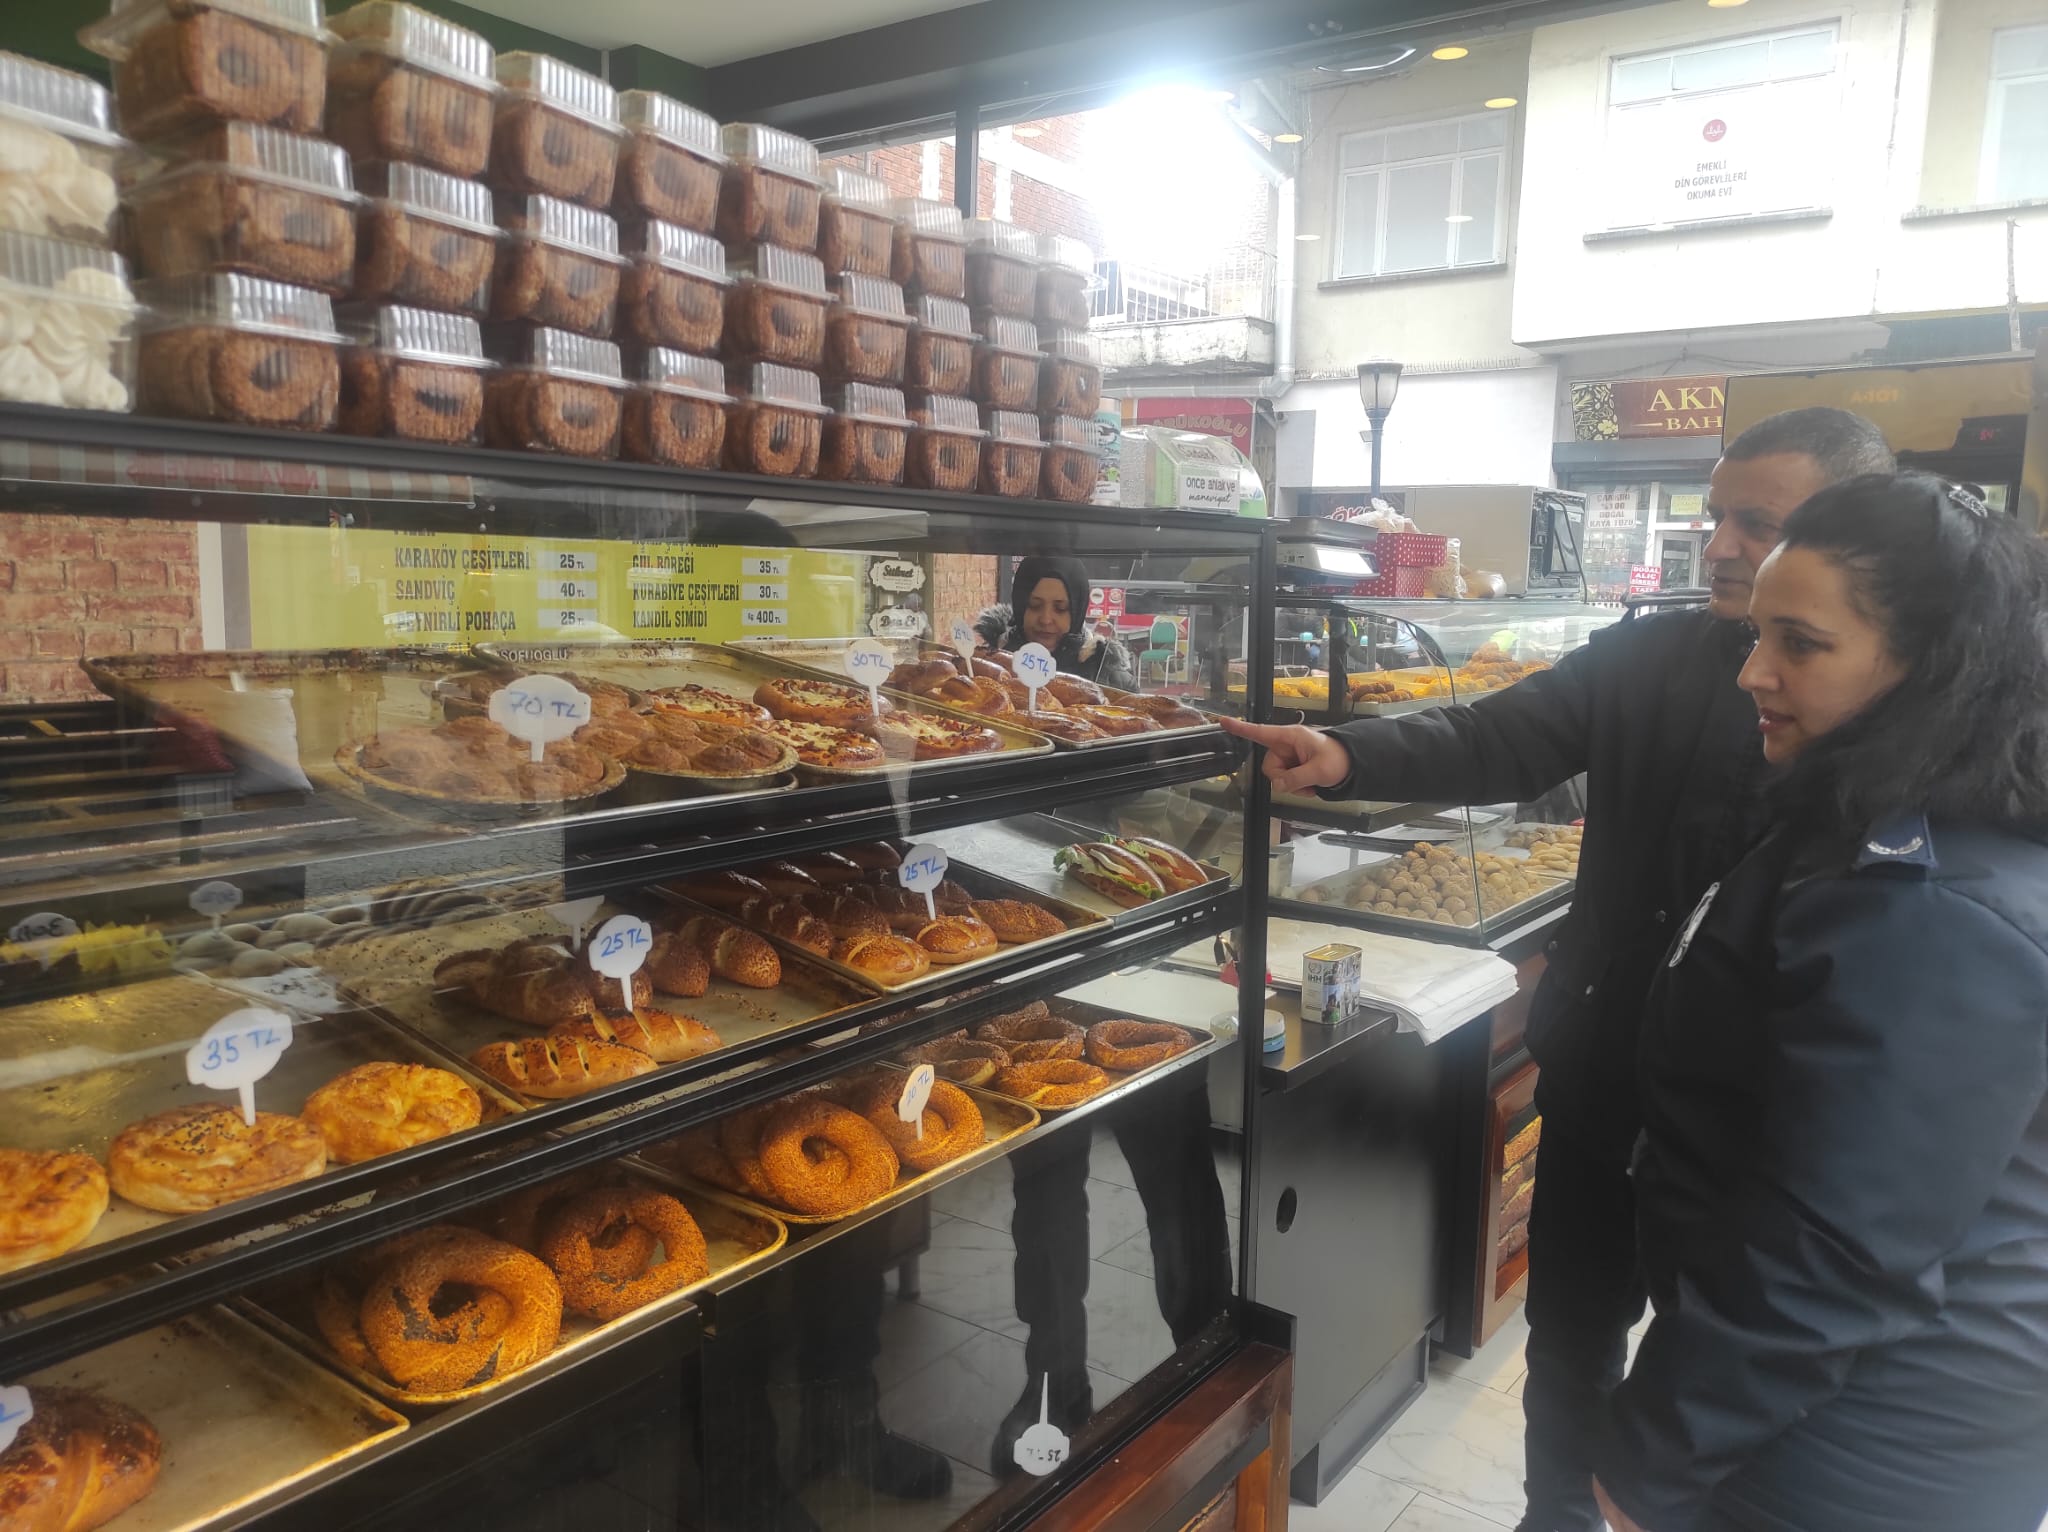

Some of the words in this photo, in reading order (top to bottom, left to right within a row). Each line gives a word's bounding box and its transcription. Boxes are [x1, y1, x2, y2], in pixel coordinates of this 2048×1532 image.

[1675, 176, 1690, 188] DİN
[1692, 170, 1747, 187] GÖREVLİLERİ
[1687, 189, 1716, 200] OKUMA
[1718, 185, 1732, 197] EVİ
[395, 544, 456, 569] KARAKÖY
[462, 545, 530, 575] ÇEŞİTLERİ
[560, 554, 575, 569] 25
[577, 561, 585, 569] TL
[759, 560, 772, 574] 35
[396, 576, 455, 605] SANDVİÇ
[560, 582, 576, 598] 40
[577, 589, 585, 598] TL
[633, 580, 684, 601] KURABİYE
[688, 580, 740, 606] ÇEŞİTLERİ
[759, 585, 772, 599] 30
[465, 610, 516, 636] POHAÇA
[560, 611, 576, 626] 25
[633, 606, 672, 628] KANDİL
[675, 606, 707, 628] SİMİDİ
[756, 610, 773, 624] 400
[852, 651, 868, 667] 30
[869, 653, 892, 670] TL
[1021, 652, 1035, 670] 25
[1037, 658, 1049, 672] TL
[509, 691, 542, 715] 70
[551, 701, 581, 718] TL
[905, 861, 919, 881] 25
[919, 856, 945, 876] TL
[600, 931, 624, 957] 25
[626, 928, 649, 949] TL
[202, 1034, 240, 1071] 35
[246, 1028, 282, 1049] TL
[1048, 1449, 1061, 1462] 25
